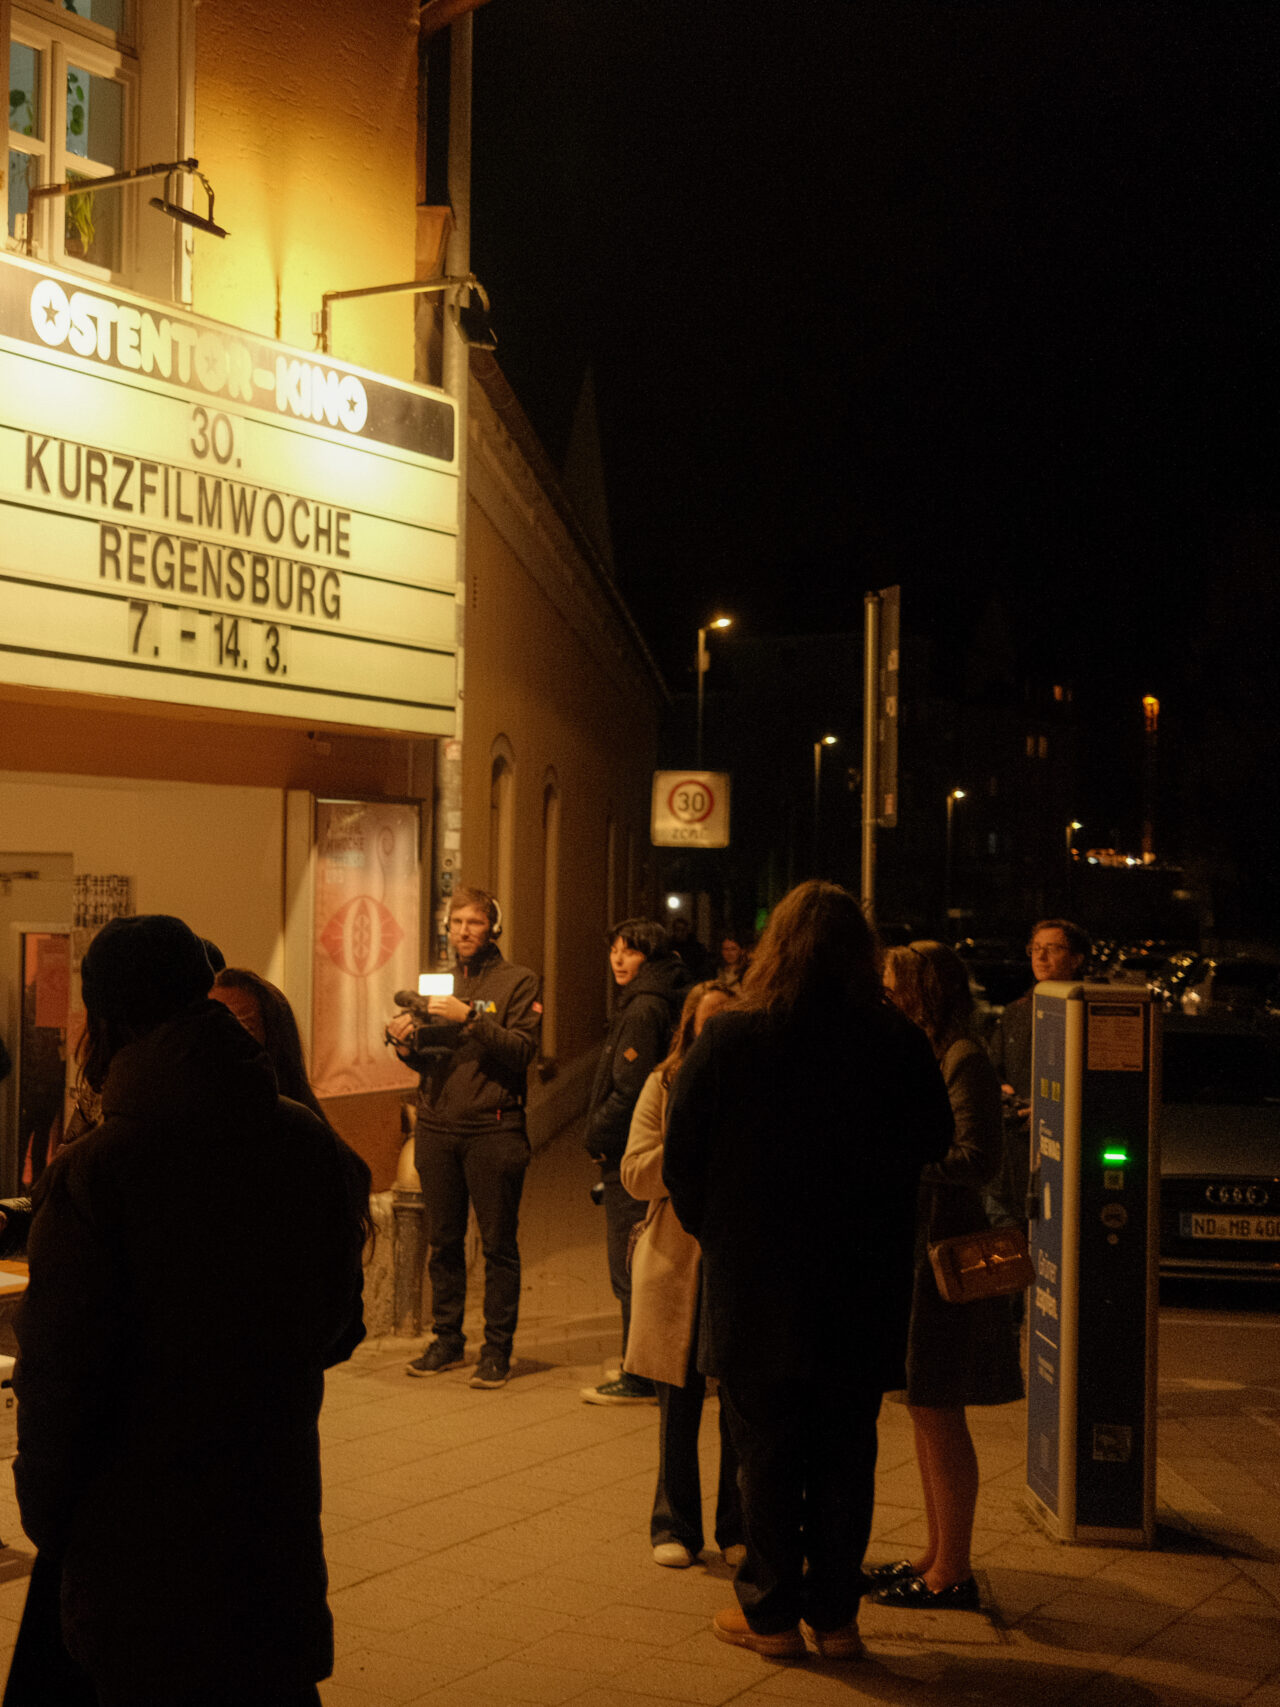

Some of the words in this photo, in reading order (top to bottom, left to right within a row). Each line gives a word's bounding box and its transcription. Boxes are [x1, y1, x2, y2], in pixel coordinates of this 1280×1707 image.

[30, 279, 368, 433] OSTENTOR-KINO
[190, 406, 242, 469] 30.
[24, 434, 352, 558] KURZFILMWOCHE
[98, 524, 341, 620] REGENSBURG
[129, 602, 159, 657] 7.
[214, 616, 248, 669] 14.
[265, 625, 288, 674] 3.
[677, 792, 705, 812] 30
